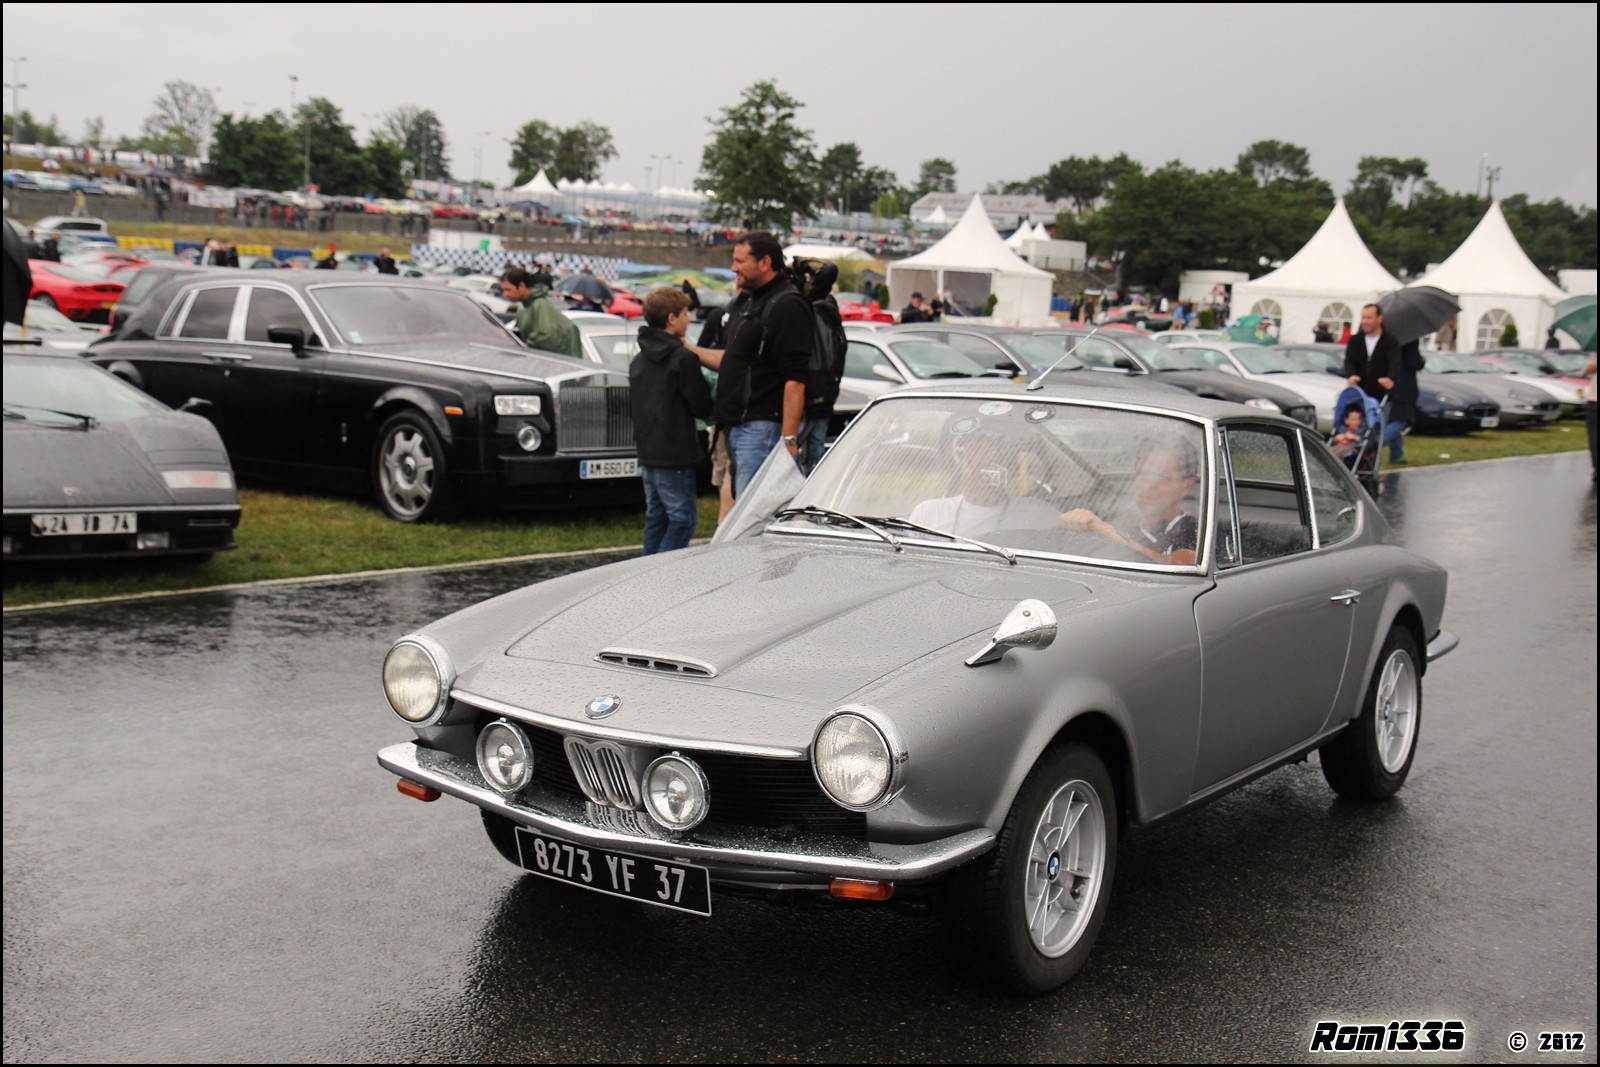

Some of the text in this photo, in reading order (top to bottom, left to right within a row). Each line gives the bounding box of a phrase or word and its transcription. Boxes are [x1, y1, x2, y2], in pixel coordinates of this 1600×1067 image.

[533, 838, 685, 903] 8273 YF 37
